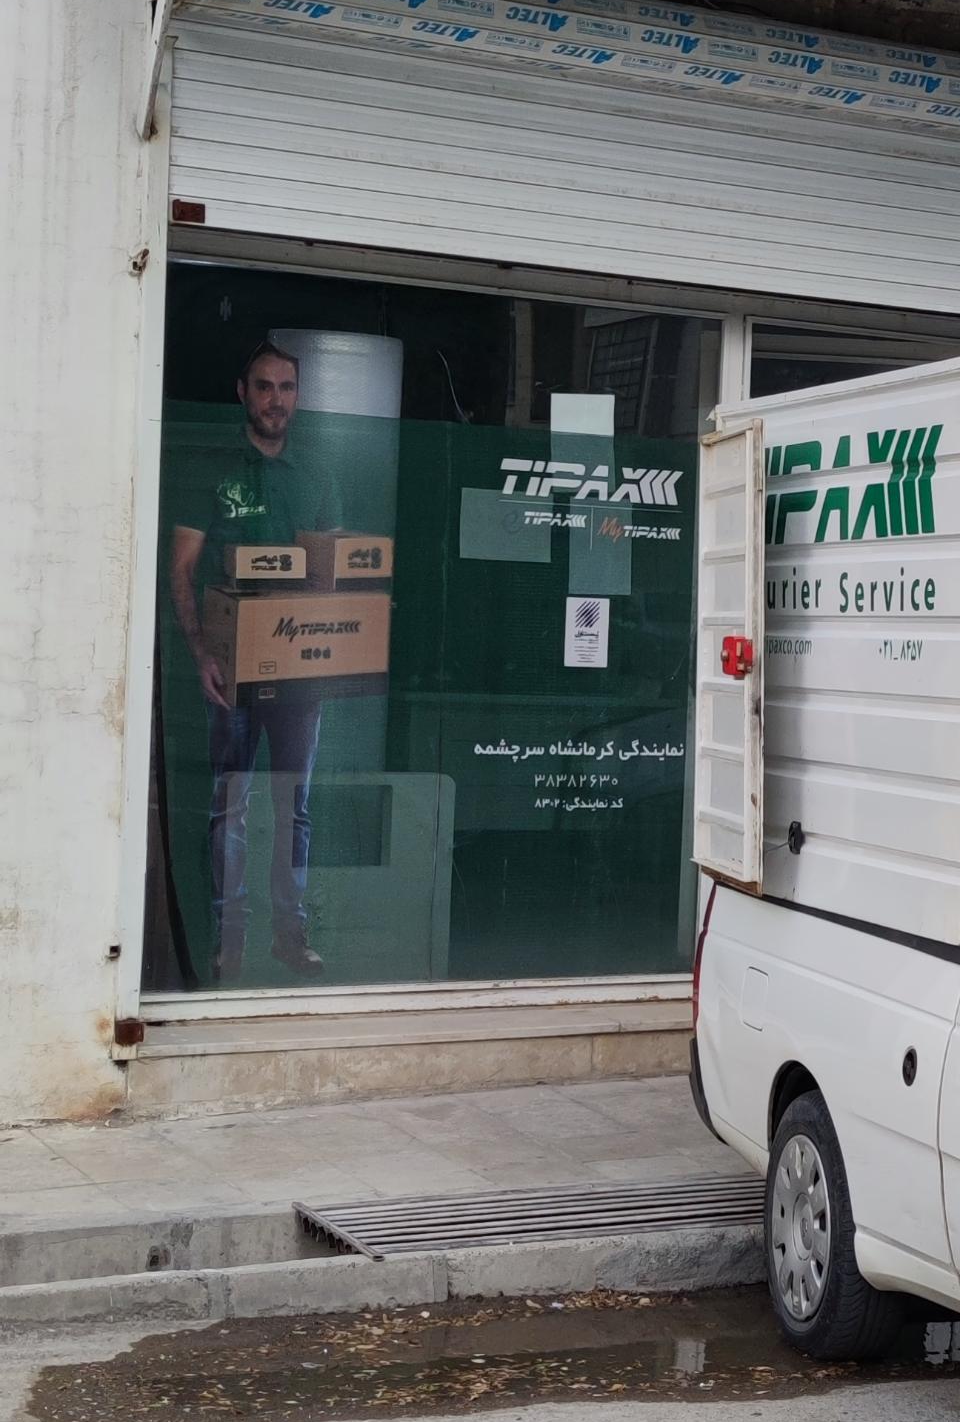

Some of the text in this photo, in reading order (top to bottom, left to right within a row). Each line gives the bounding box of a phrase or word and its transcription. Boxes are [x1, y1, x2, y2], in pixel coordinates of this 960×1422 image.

[505, 5, 569, 32] ALTEC
[640, 28, 702, 54] ALTEC
[767, 50, 825, 75] ALTEC
[888, 70, 944, 94] ALTEC
[638, 5, 696, 27] ALTEC
[765, 28, 820, 49] ALTEC
[885, 49, 938, 68] ALTEC
[412, 20, 481, 43] ALTEC
[552, 43, 617, 65] ALTEC
[683, 65, 745, 86] ALTEC
[808, 85, 867, 105] ALTEC
[500, 458, 684, 507] TIPAX
[764, 424, 944, 546] IPAX
[766, 567, 936, 614] urier Service
[766, 635, 813, 658] ipaxco.com
[474, 738, 685, 763] نمایندگی کرمانشاه سرچشمه
[534, 773, 619, 788] ۳۸۳۸۲۶۳۰
[610, 797, 624, 809] کد
